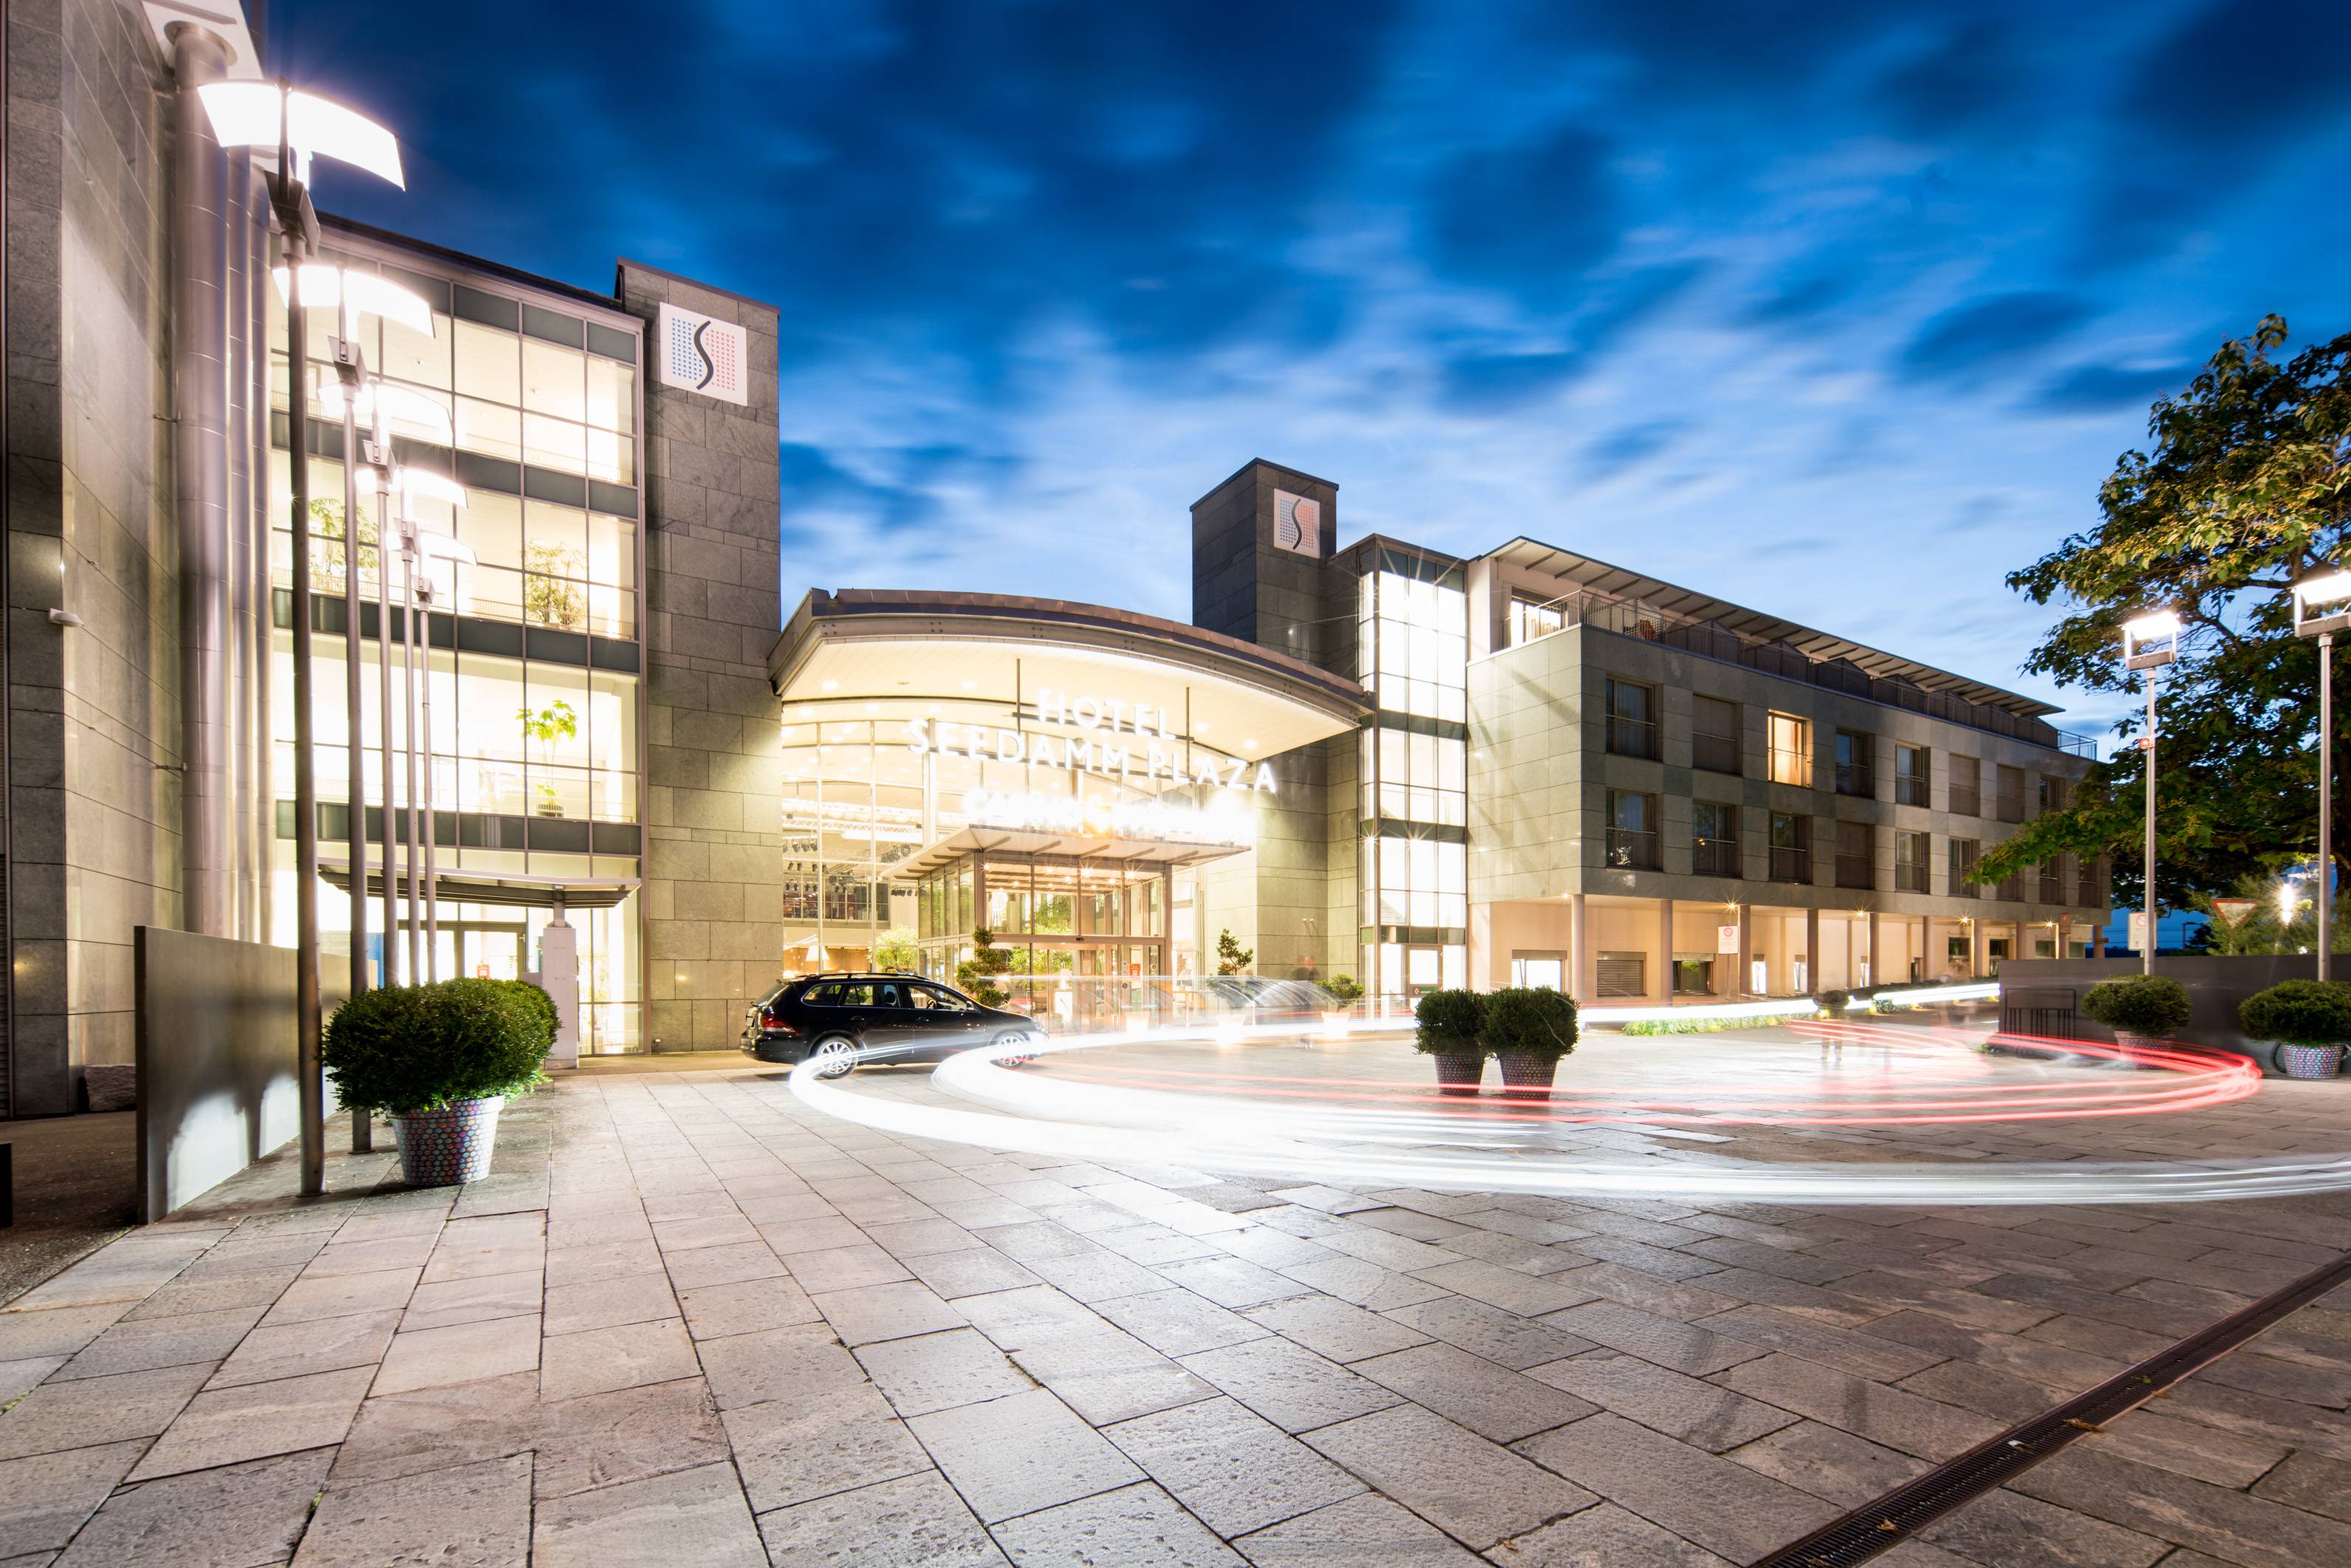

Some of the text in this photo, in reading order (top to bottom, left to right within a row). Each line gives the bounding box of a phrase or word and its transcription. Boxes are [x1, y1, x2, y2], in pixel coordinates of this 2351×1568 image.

[1038, 690, 1176, 740] HOTEL
[908, 718, 1277, 794] SEEDAMM PLAZA
